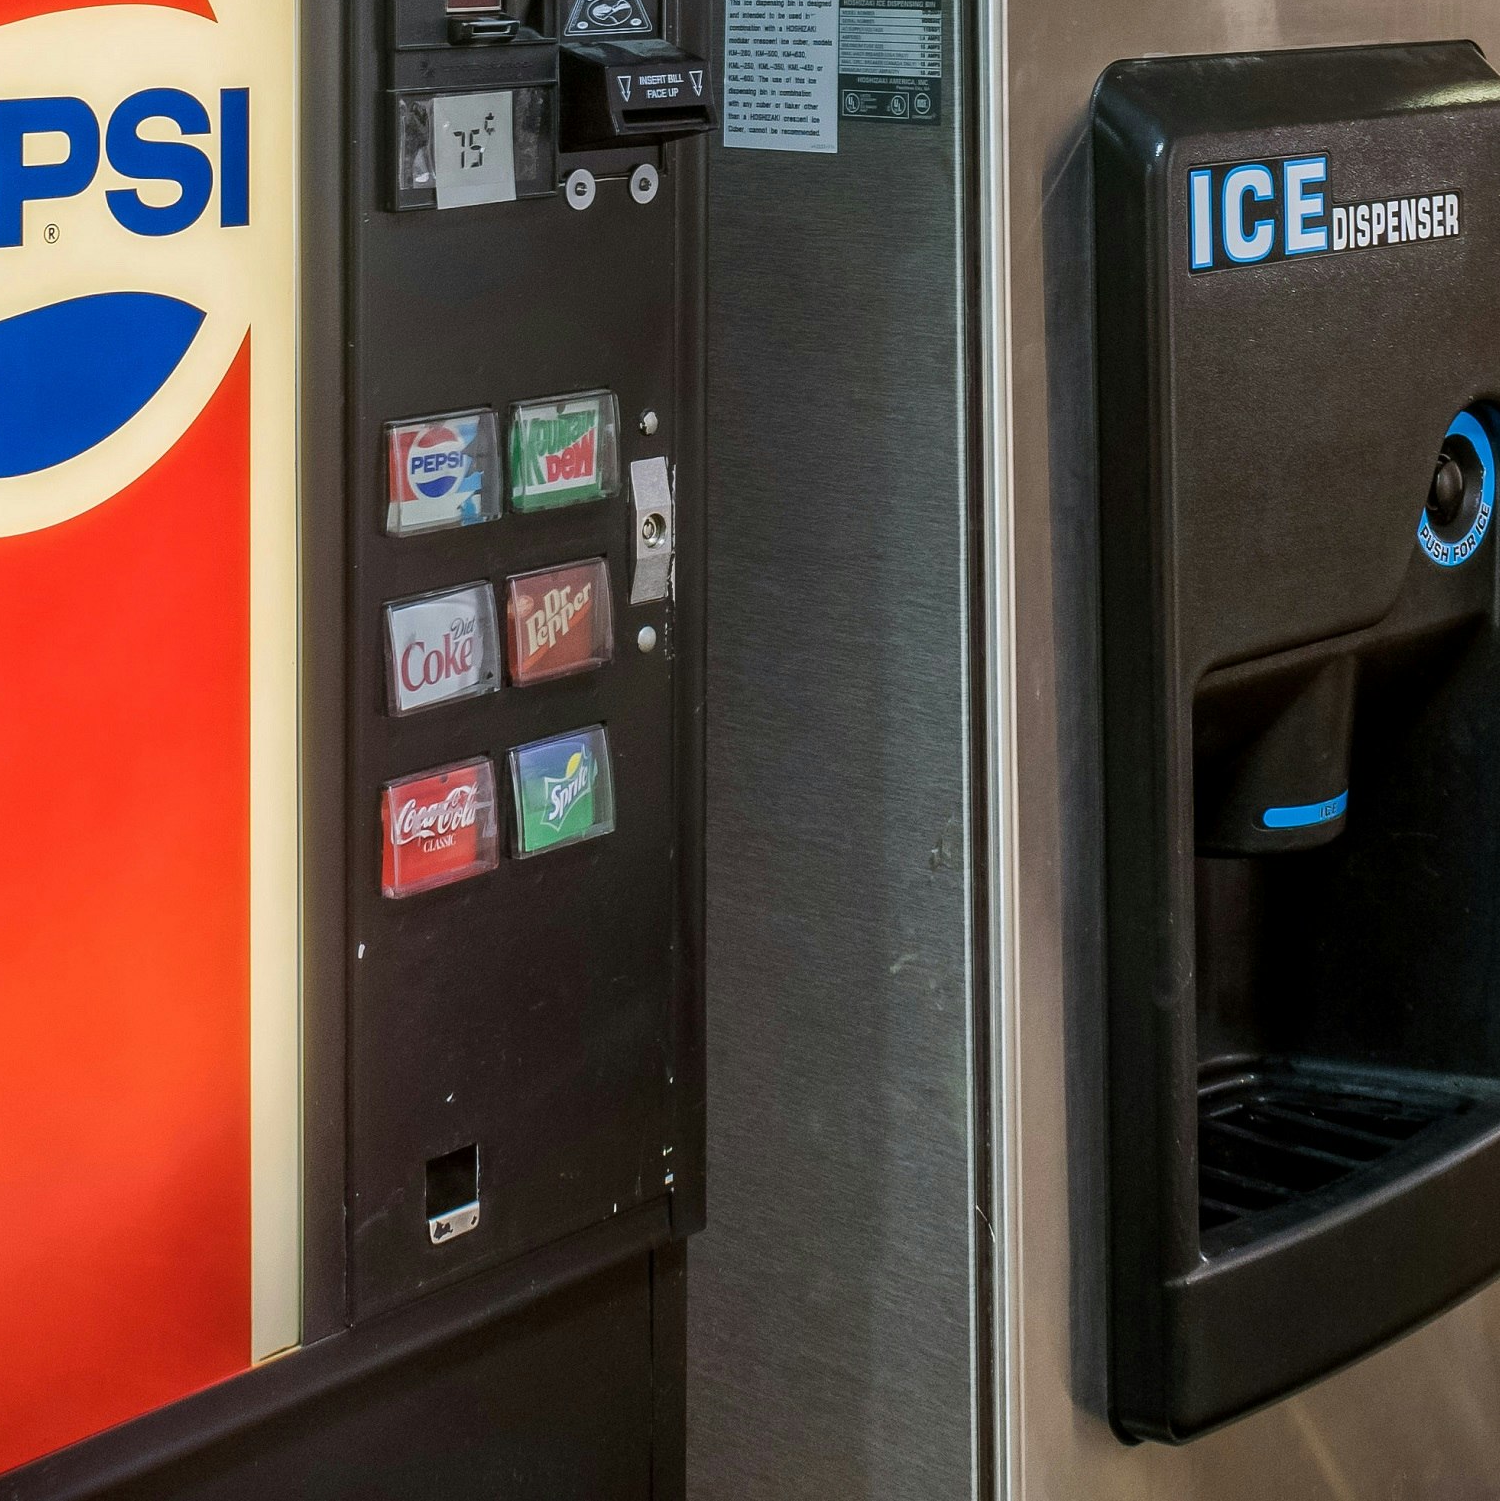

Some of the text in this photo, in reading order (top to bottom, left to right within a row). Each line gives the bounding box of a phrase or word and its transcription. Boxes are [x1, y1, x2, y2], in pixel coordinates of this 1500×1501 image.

[756, 0, 785, 8] dispensing
[843, 0, 875, 7] HOSHIZAKI
[639, 73, 684, 85] INSERT BILL
[646, 87, 679, 99] FACE UP
[750, 113, 780, 121] HOSHIZAKI
[1190, 156, 1459, 269] ICE DISPENSER
[411, 451, 464, 475] PEPSI
[1420, 503, 1491, 562] PUSH FOR ICE
[543, 584, 571, 615] Dr
[451, 616, 477, 641] Diet
[526, 582, 592, 656] Pepper
[401, 632, 474, 692] Coke
[549, 765, 589, 821] Sprite
[423, 833, 457, 853] CLASSIC
